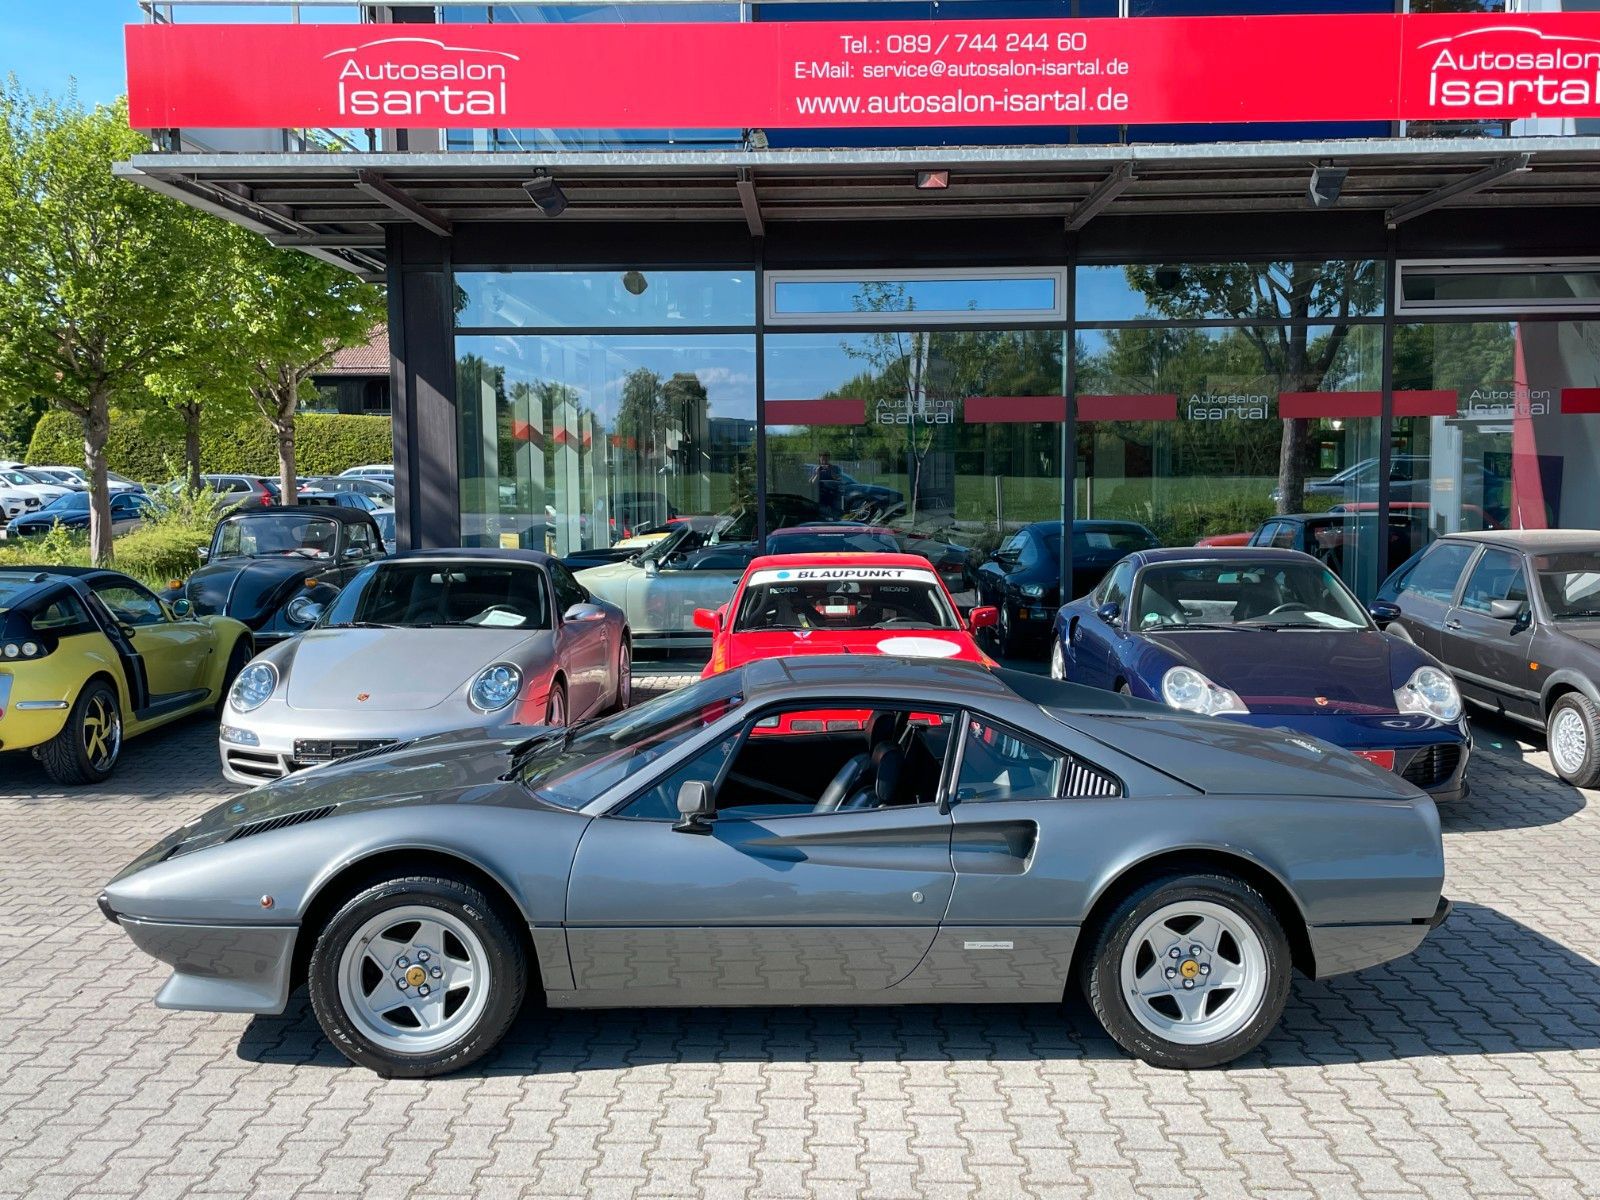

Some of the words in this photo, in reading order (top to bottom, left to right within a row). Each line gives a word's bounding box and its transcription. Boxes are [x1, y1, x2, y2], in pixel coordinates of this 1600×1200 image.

[840, 35, 880, 54] Tel.:
[1005, 32, 1049, 52] 244
[1057, 32, 1087, 52] 60
[794, 61, 854, 79] E-Mail:
[862, 58, 1129, 78] service@autosalon-isartal.de
[1432, 48, 1600, 71] Autosalon
[339, 58, 505, 81] Autosalon
[338, 81, 507, 116] Isartal
[796, 86, 1129, 114] www.autosalon-isartal.de
[876, 398, 954, 408] Autosalon
[1188, 393, 1269, 404] Autosalon
[1469, 389, 1550, 400] Autosalon
[875, 408, 954, 425] Isartal
[1187, 403, 1269, 420] Isartal
[797, 570, 905, 579] BLAUPUNKT
